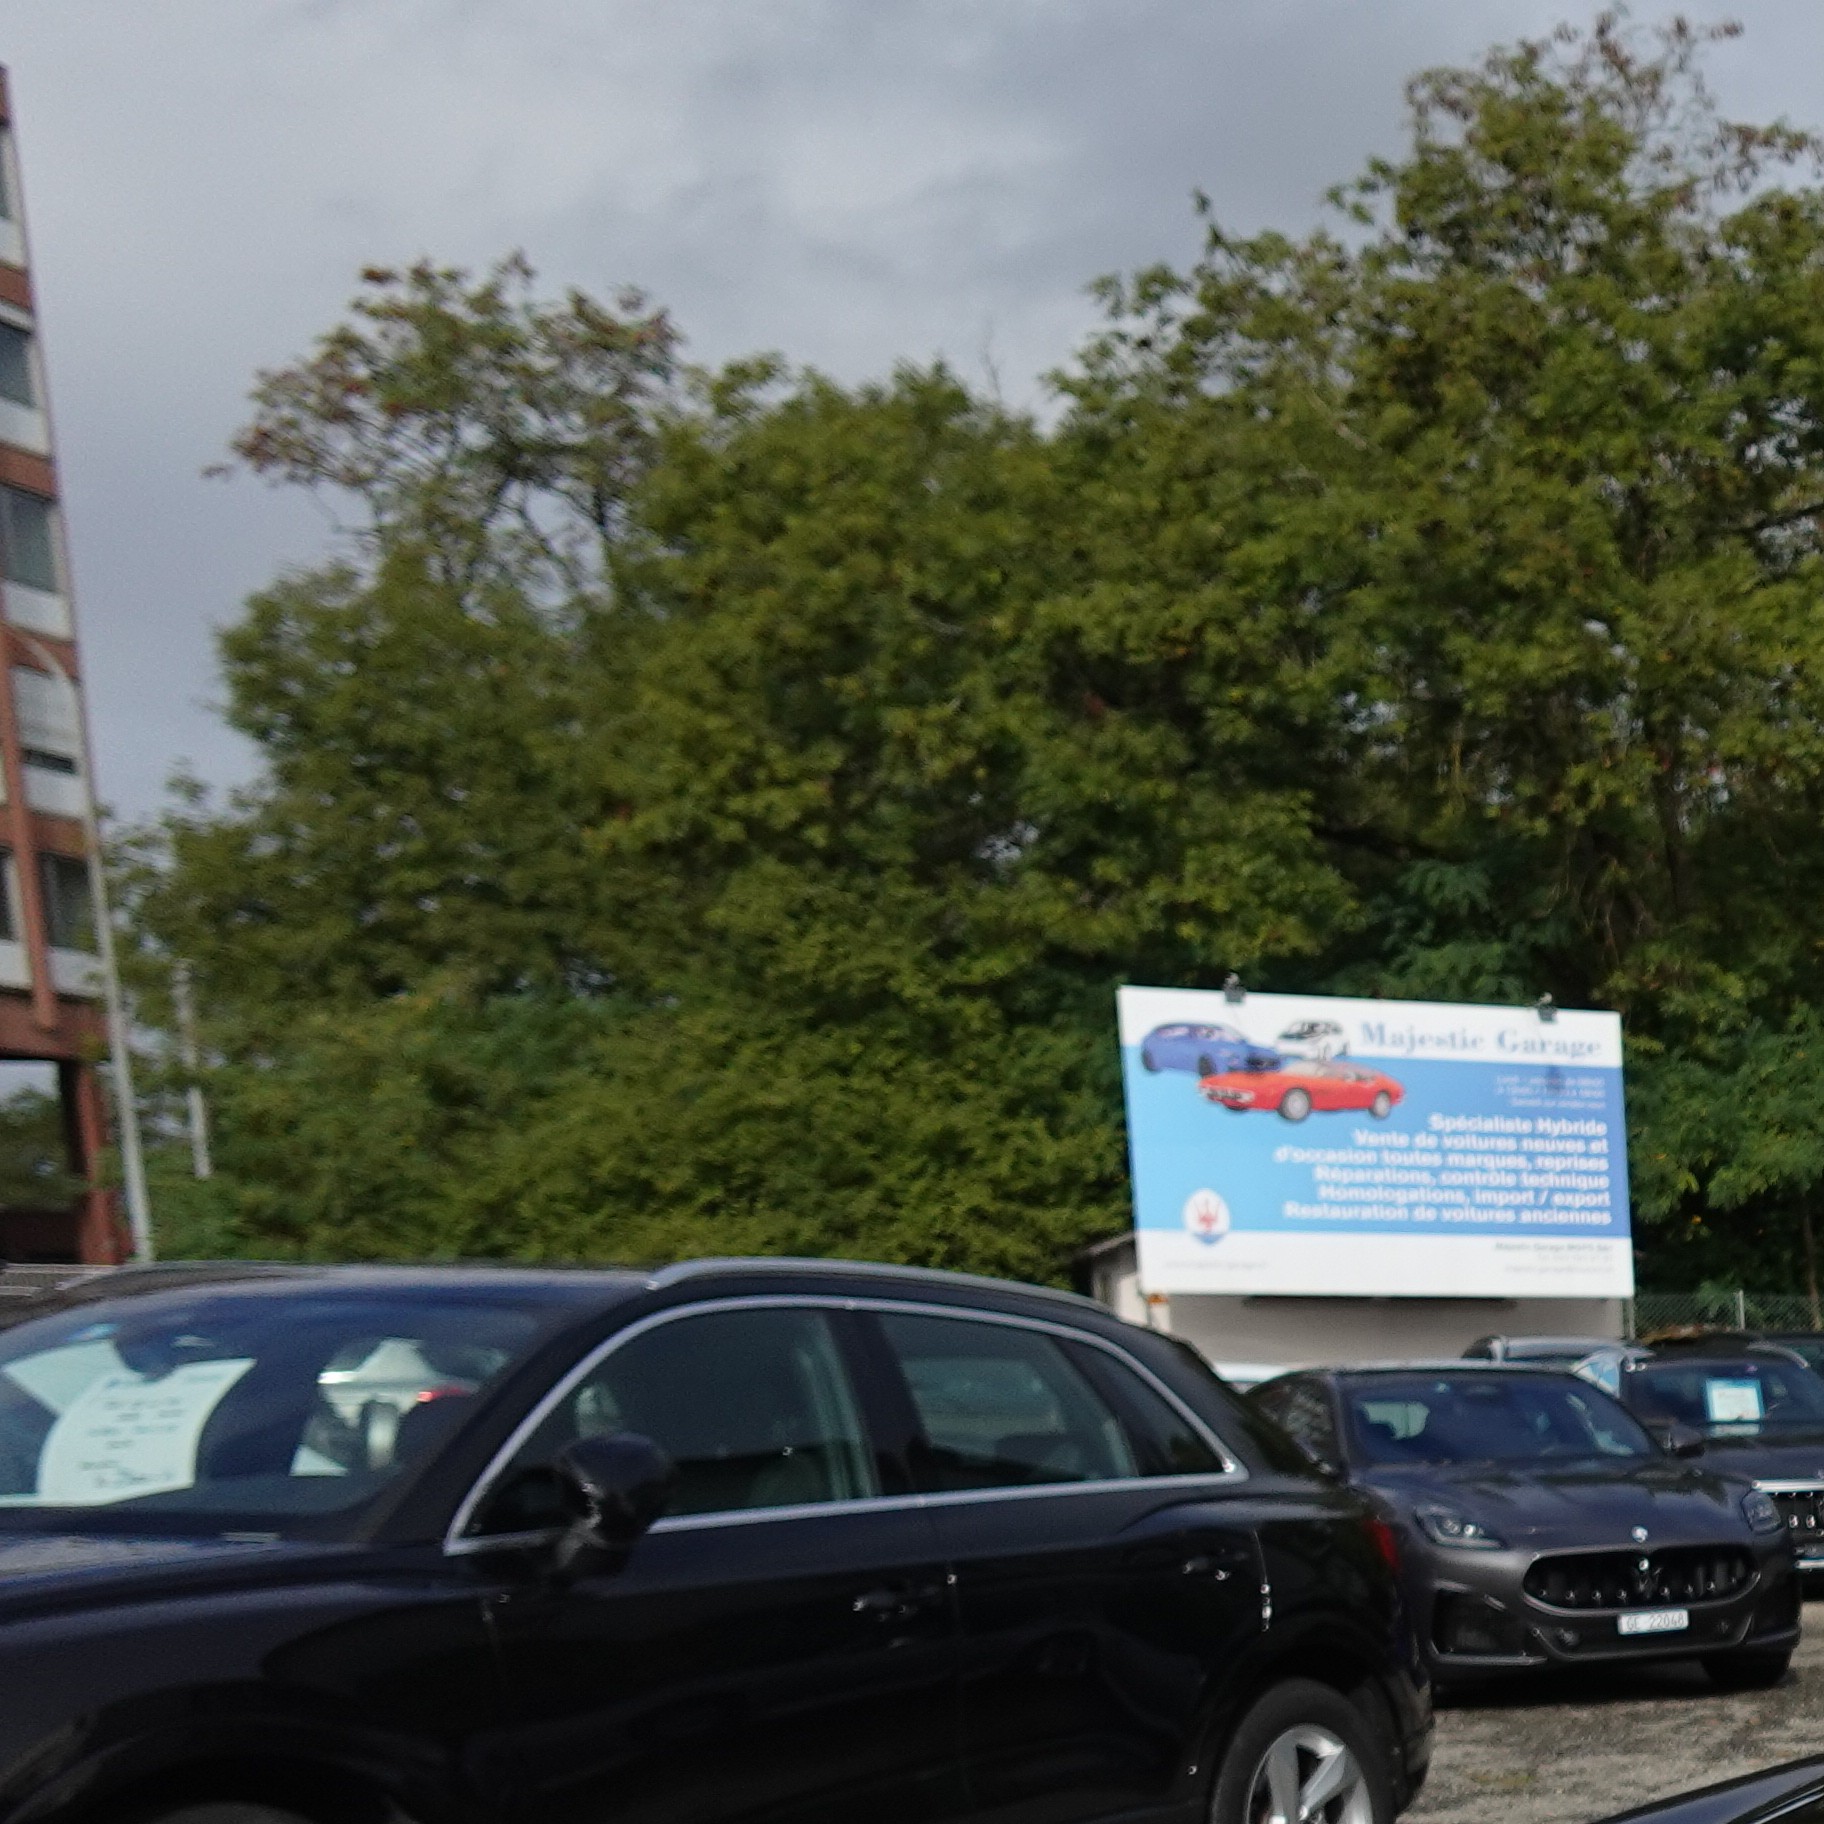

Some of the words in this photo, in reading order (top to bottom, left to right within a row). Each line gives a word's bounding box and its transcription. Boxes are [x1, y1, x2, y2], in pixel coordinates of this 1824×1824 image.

[1361, 1021, 1484, 1054] Majestic
[1497, 1028, 1600, 1057] Garage
[1429, 1112, 1533, 1133] Spécialiste
[1536, 1117, 1608, 1137] Hybride
[1354, 1129, 1409, 1148] Vente
[1413, 1132, 1438, 1148] de
[1443, 1134, 1517, 1151] voitures
[1521, 1138, 1586, 1154] neuves
[1589, 1138, 1609, 1154] et
[1274, 1146, 1377, 1163] d'occasion
[1382, 1150, 1442, 1167] toutes
[1447, 1153, 1532, 1170] marques,
[1535, 1154, 1609, 1172] reprises
[1314, 1164, 1436, 1185] Réparations,
[1440, 1171, 1516, 1187] contrôle
[1520, 1173, 1610, 1190] technique
[1318, 1184, 1470, 1205] Homologations,
[1474, 1188, 1535, 1207] import
[1538, 1190, 1549, 1205] /
[1552, 1191, 1611, 1209] export
[1284, 1201, 1409, 1220] Restauration
[1413, 1206, 1438, 1222] de
[1441, 1207, 1516, 1223] voitures
[1519, 1208, 1613, 1226] anciennes
